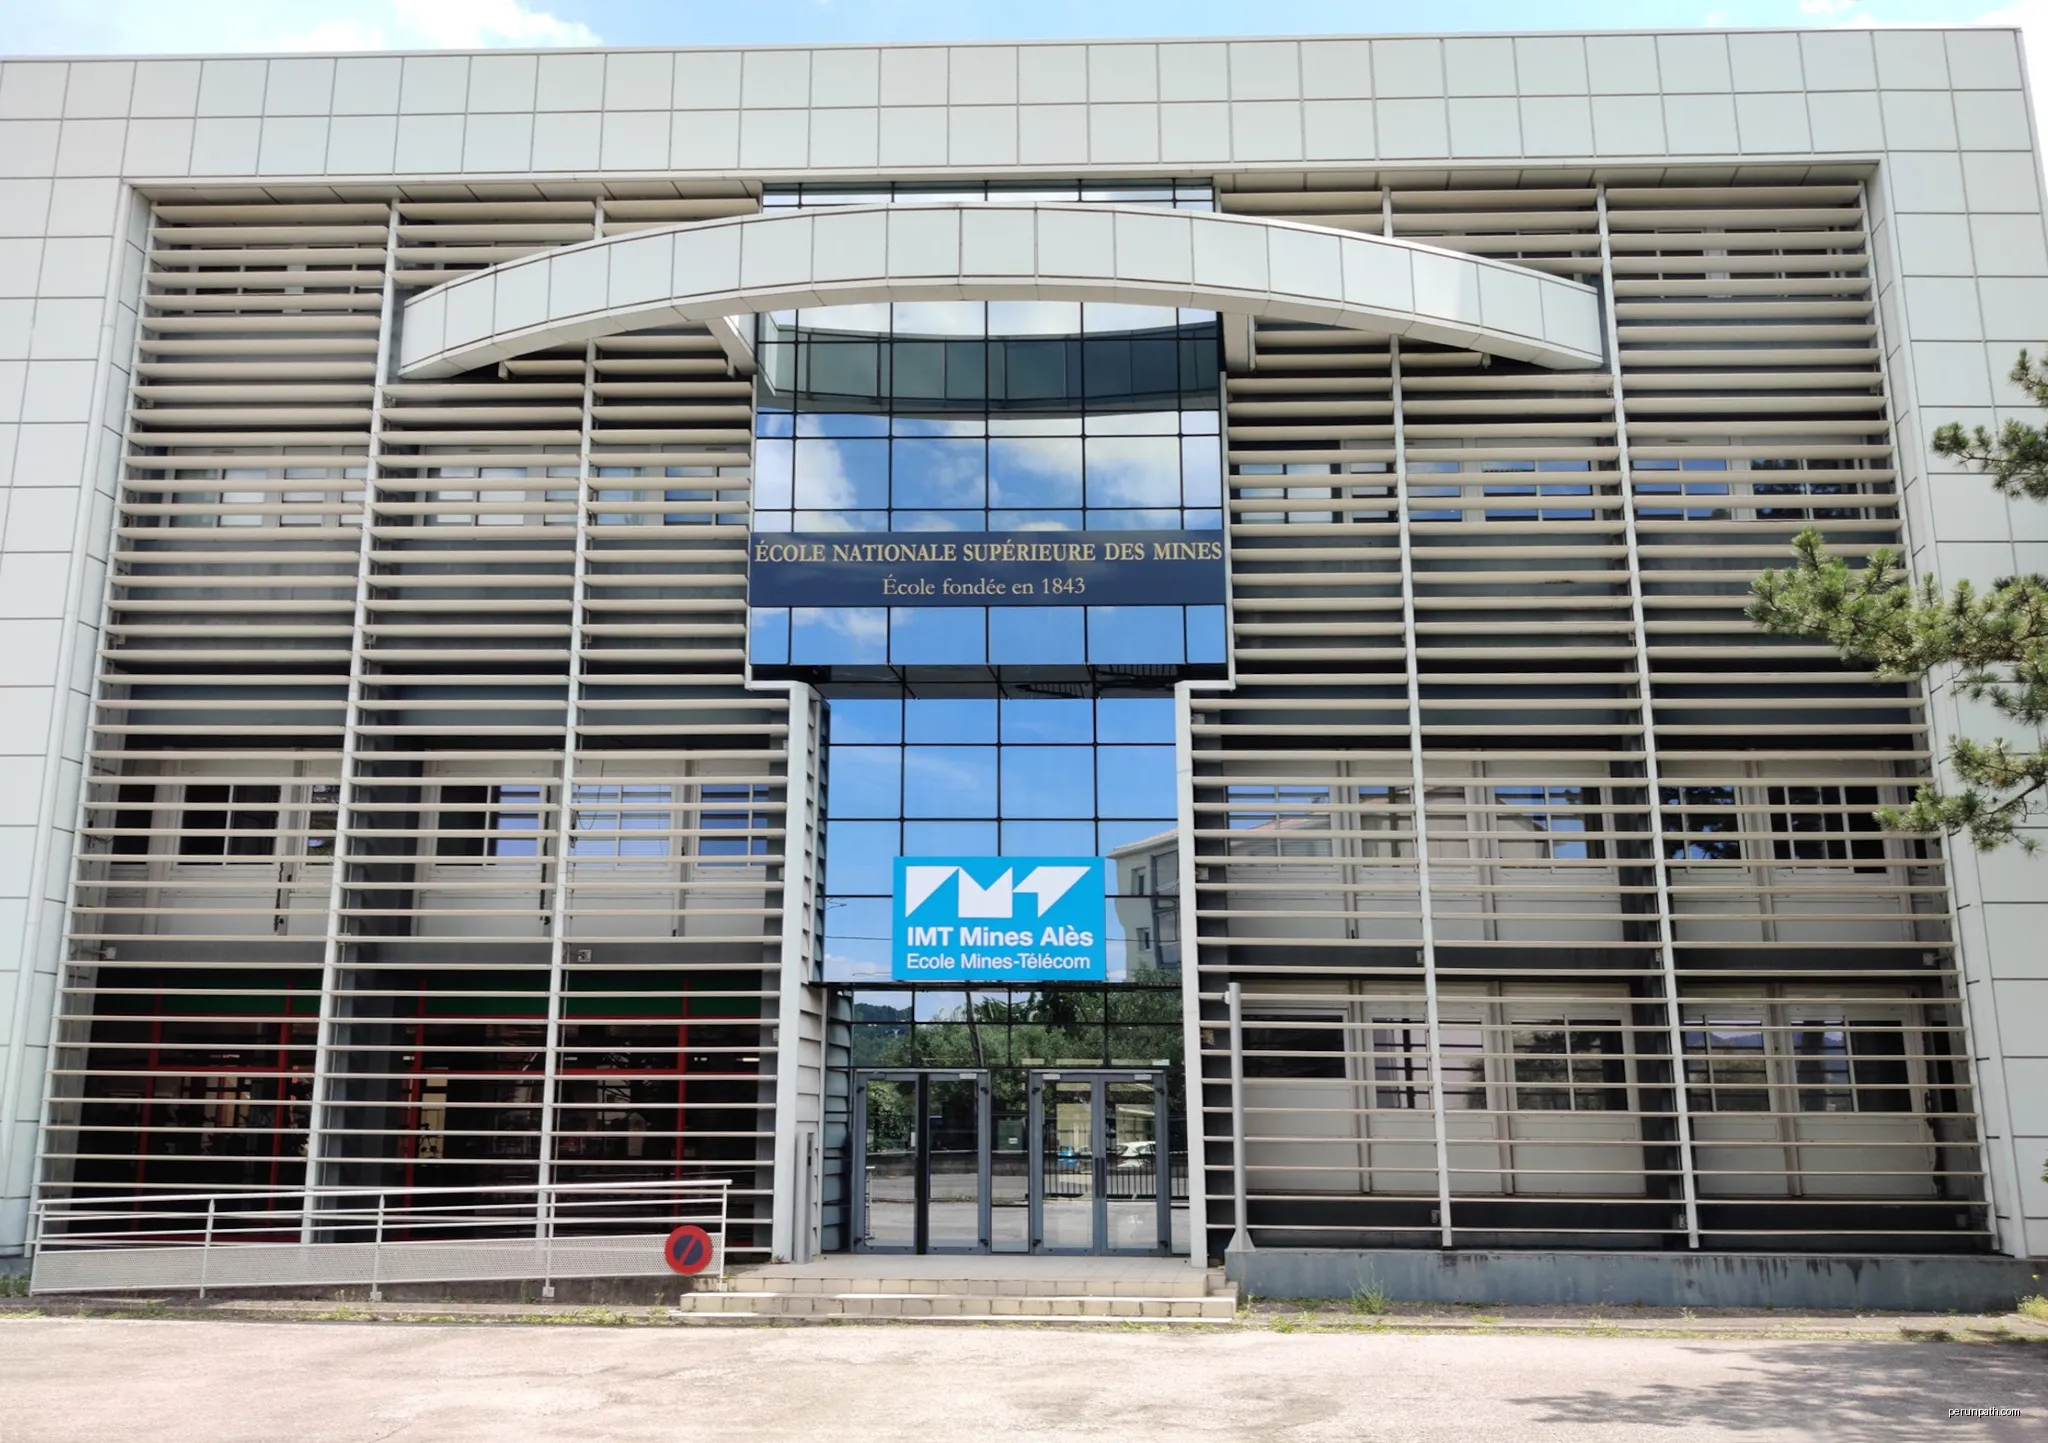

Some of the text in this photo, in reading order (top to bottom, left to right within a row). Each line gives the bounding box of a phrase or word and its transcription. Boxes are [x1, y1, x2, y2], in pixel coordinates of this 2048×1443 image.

[755, 539, 1222, 562] ÉCOLE NATIONALE SUPÉRIEURE DES MINES
[882, 573, 1085, 595] École fondée en 1843
[907, 925, 1094, 947] IMT Mines Alès
[907, 953, 1090, 969] Ecole Mines-Télécom
